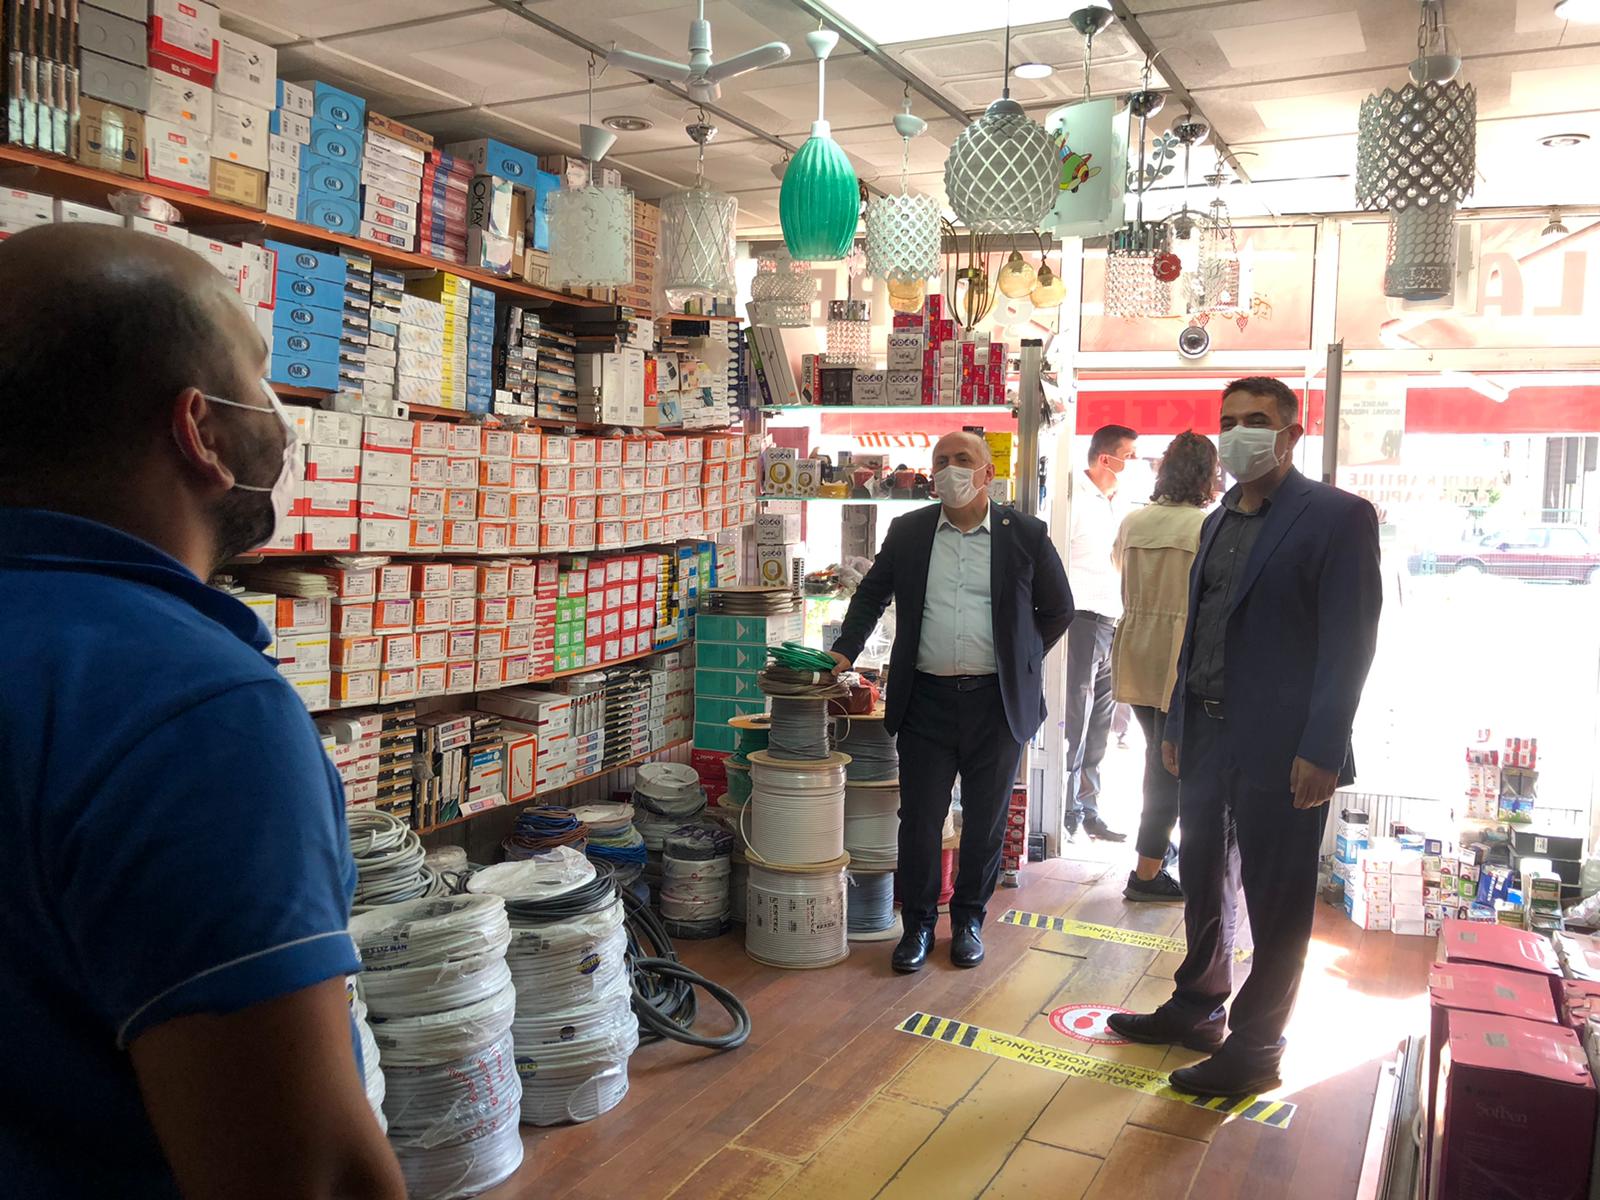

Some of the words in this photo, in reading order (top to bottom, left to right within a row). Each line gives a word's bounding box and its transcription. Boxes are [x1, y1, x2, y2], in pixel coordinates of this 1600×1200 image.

[472, 180, 486, 228] OKTAY
[297, 255, 317, 269] ARS
[294, 282, 312, 297] ARS
[292, 310, 312, 324] ARS
[290, 338, 309, 352] ARS
[290, 365, 309, 379] ARS
